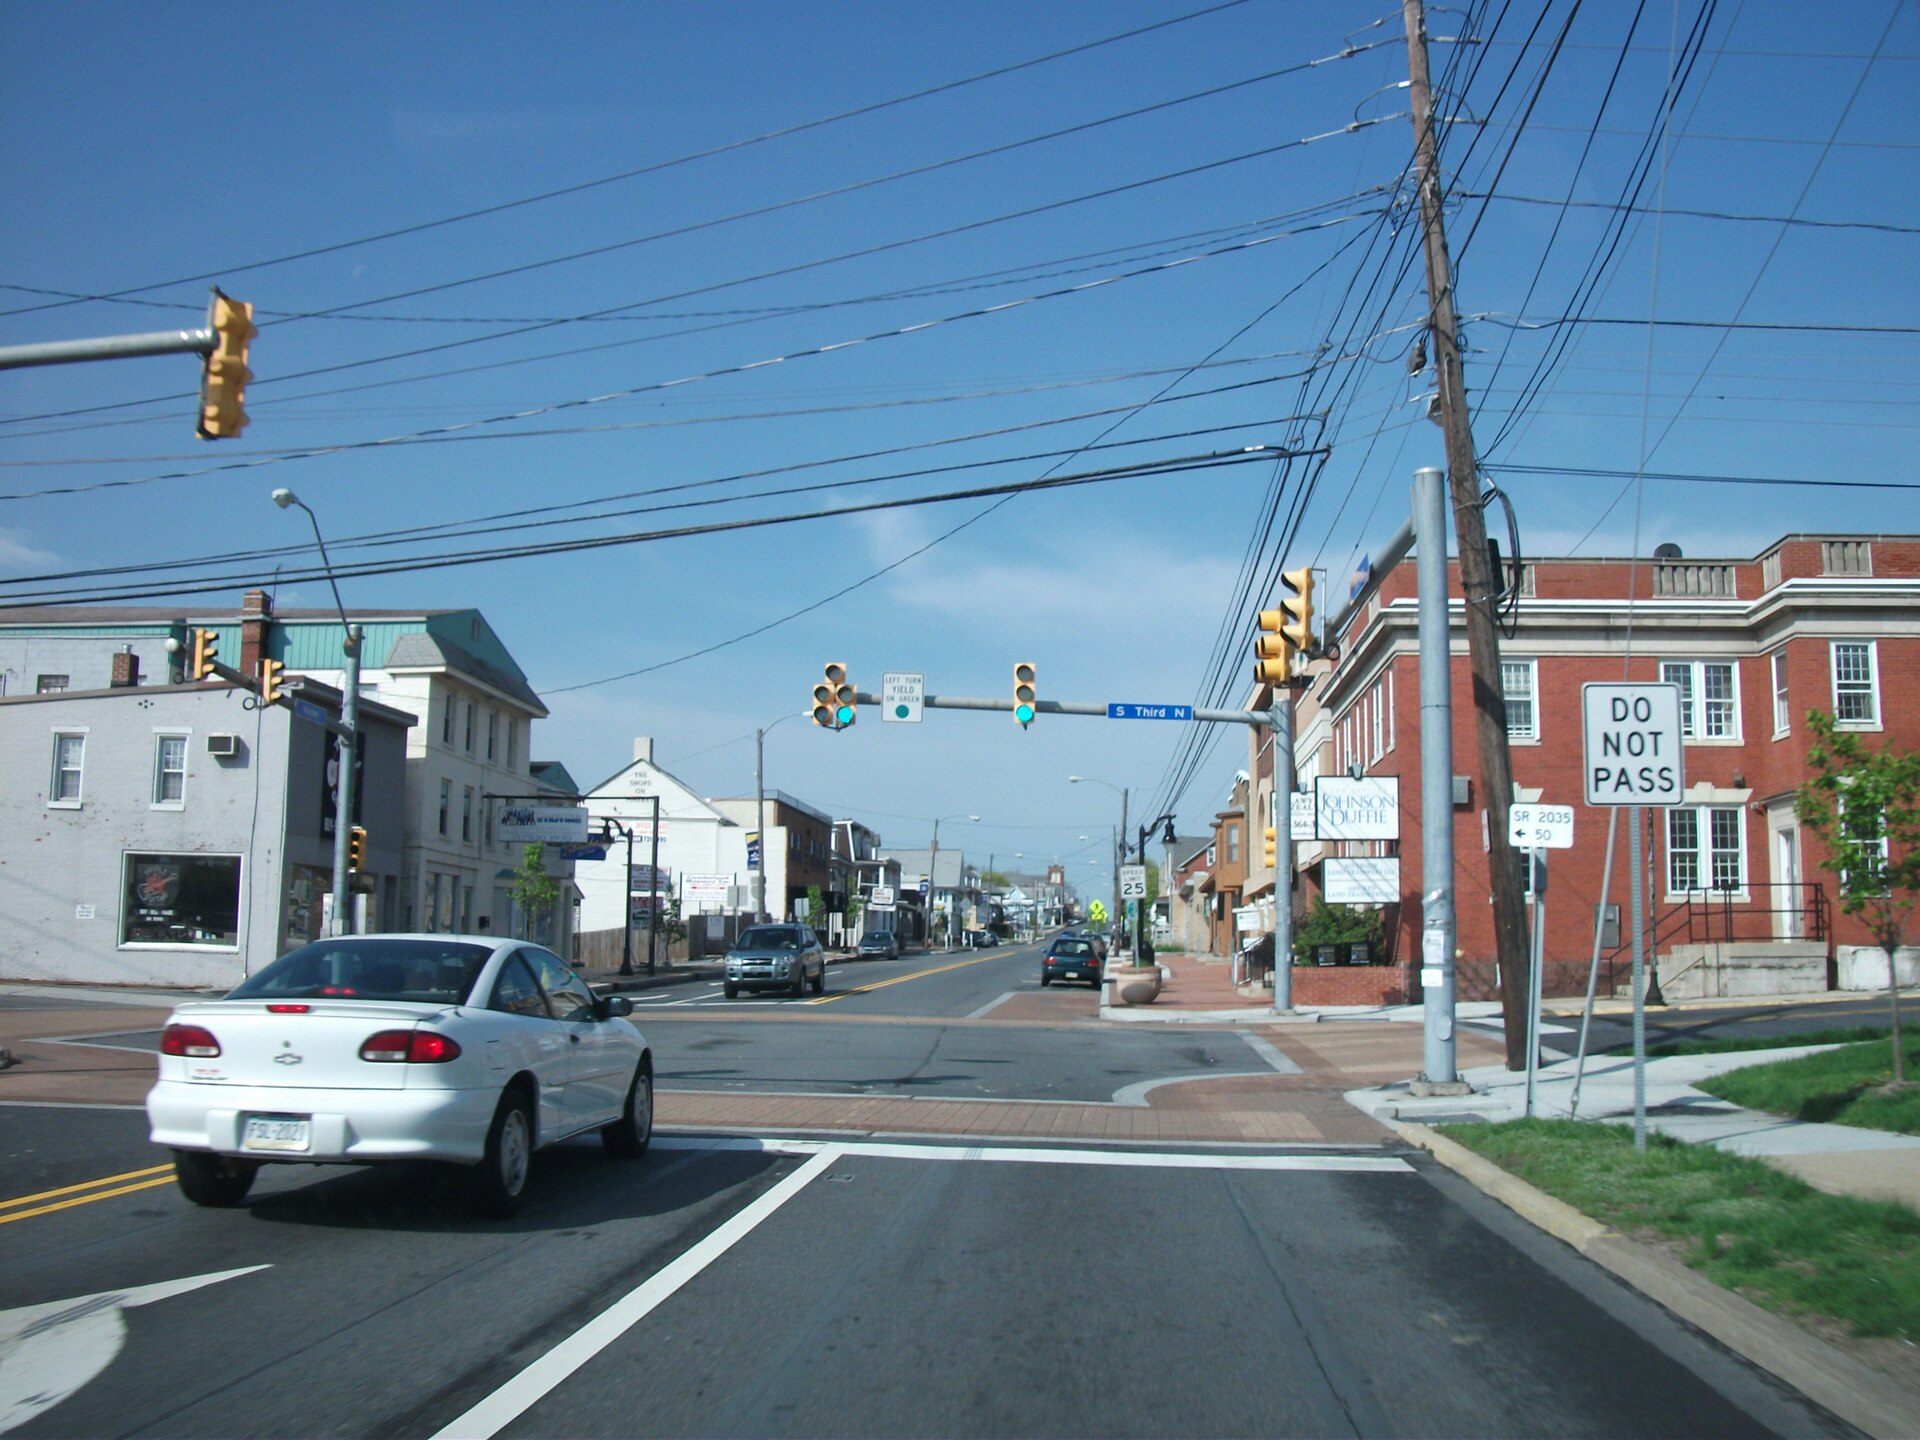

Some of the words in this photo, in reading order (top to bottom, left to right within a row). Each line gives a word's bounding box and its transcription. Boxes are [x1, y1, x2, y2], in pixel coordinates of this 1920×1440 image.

[885, 676, 900, 684] LEFT
[893, 686, 915, 694] YIELD
[1116, 705, 1125, 717] S
[1135, 706, 1166, 718] Third
[1174, 708, 1185, 718] N
[1612, 697, 1651, 722] DO
[1603, 731, 1664, 757] NOT
[1594, 767, 1674, 793] PASS
[1321, 793, 1395, 815] JOHNSON
[1331, 809, 1387, 826] DUFFIE
[1514, 810, 1530, 822] SR
[1538, 811, 1571, 824] 2035
[1535, 828, 1552, 841] 50
[1123, 883, 1144, 895] 25
